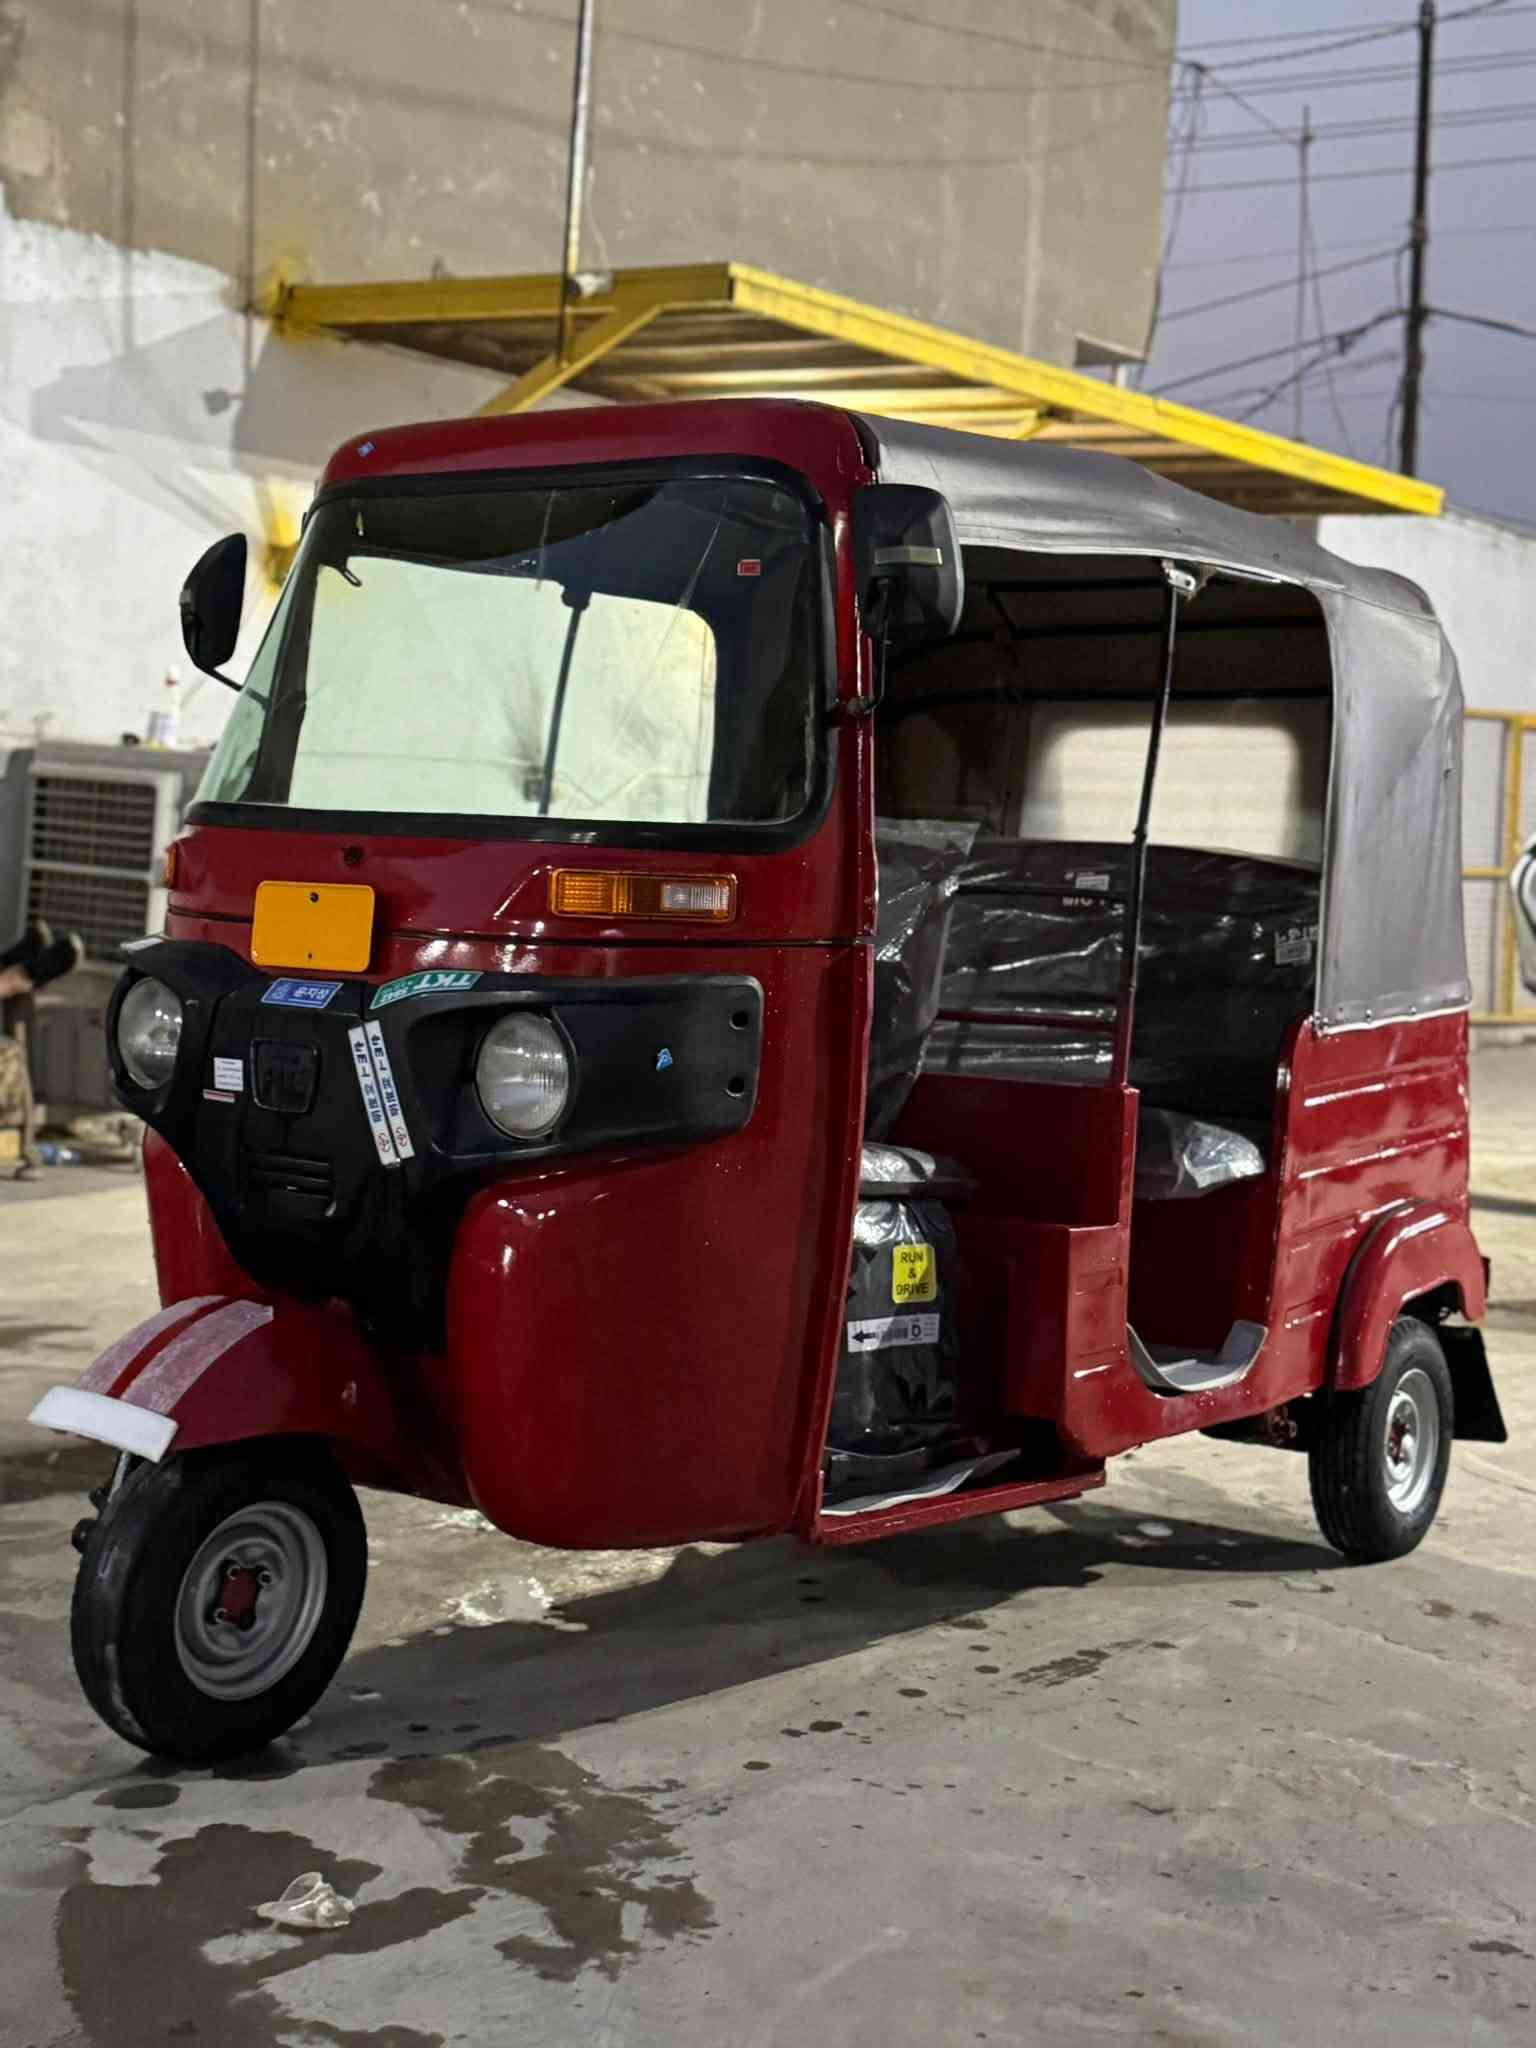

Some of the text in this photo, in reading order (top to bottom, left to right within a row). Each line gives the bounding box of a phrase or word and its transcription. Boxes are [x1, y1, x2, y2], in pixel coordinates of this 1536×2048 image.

[900, 1251, 924, 1263] RUN
[908, 1267, 917, 1279] &
[895, 1282, 929, 1296] DRIVE
